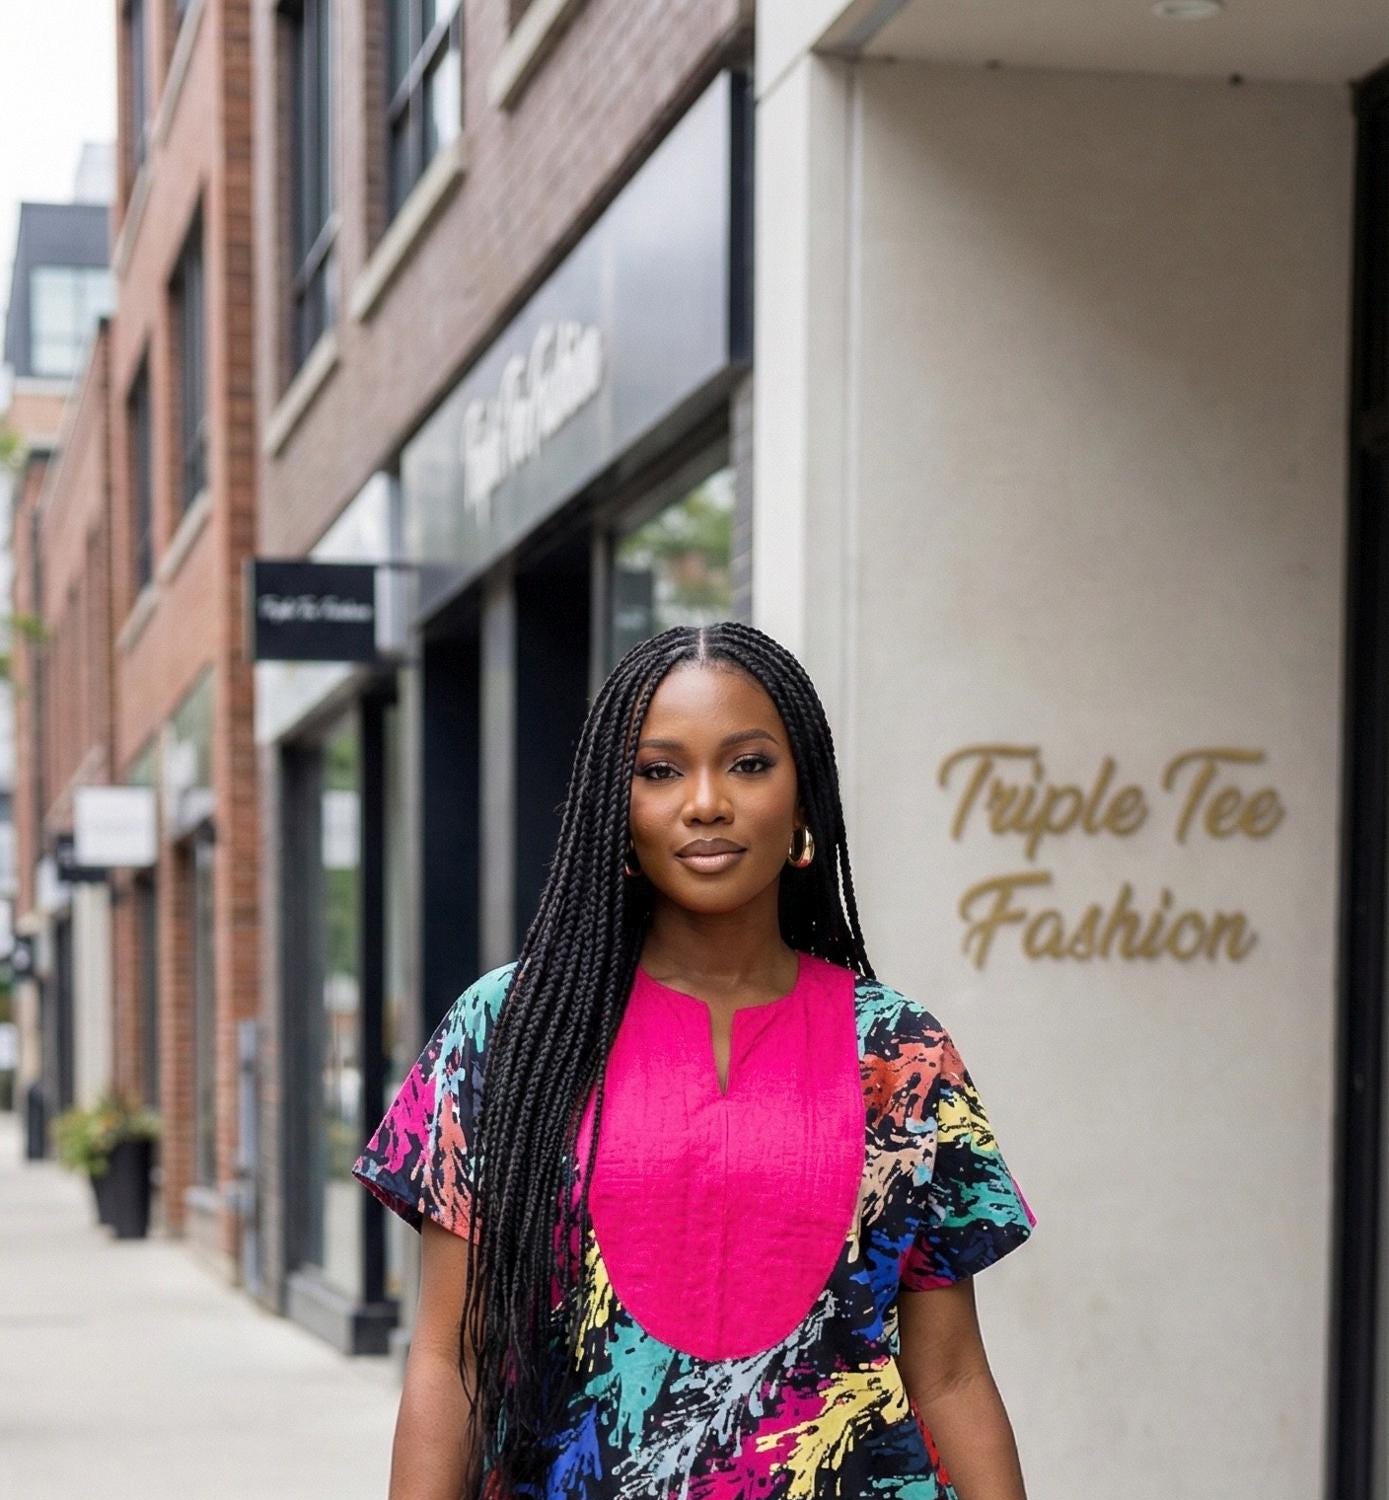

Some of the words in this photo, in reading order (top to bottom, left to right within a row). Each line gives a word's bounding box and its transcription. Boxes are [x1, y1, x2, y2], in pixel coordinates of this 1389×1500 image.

[937, 742, 1149, 861] Triple
[1161, 746, 1286, 845] Tee
[957, 870, 1258, 971] Fashion
